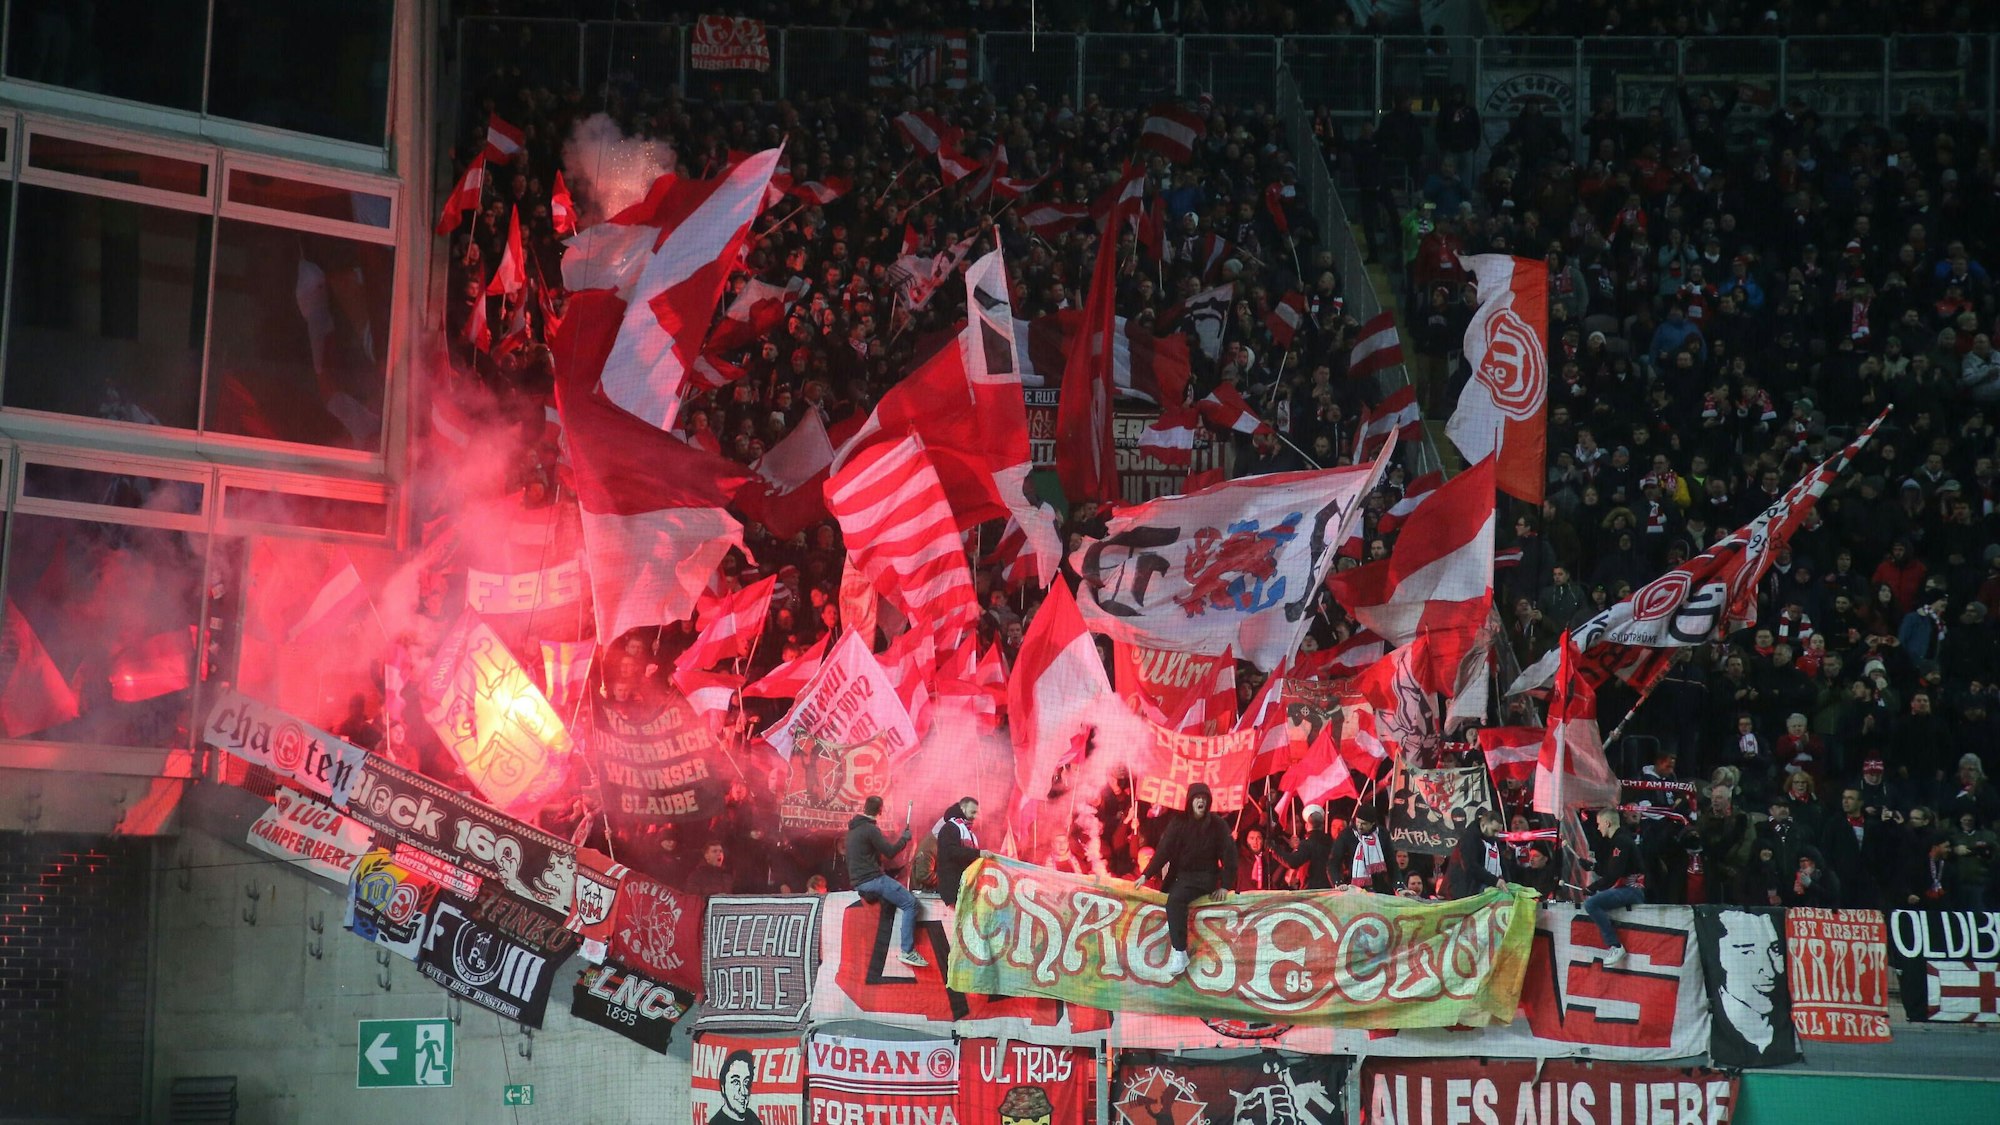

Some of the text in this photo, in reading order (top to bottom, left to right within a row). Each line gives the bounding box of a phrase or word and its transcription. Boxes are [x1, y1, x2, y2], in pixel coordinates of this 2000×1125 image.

[1169, 753, 1221, 784] PER
[288, 804, 344, 836] LUCA
[621, 789, 698, 815] GLAUBE
[251, 818, 357, 871] KÄMPFERHERZ
[453, 817, 523, 870] 160
[625, 881, 683, 922] FORTUNA
[711, 914, 807, 959] VECCHIO
[1793, 921, 1880, 941] IST UNSERE
[1891, 908, 2000, 959] OLDB
[711, 966, 792, 1010] IDEALE
[1789, 937, 1887, 1005] KRAFT
[588, 965, 676, 1020] LNC
[606, 1003, 637, 1027] 1895
[1794, 1011, 1891, 1037] ULTRAS
[813, 1042, 921, 1075] VORAN
[813, 1097, 959, 1125] FORTUNA
